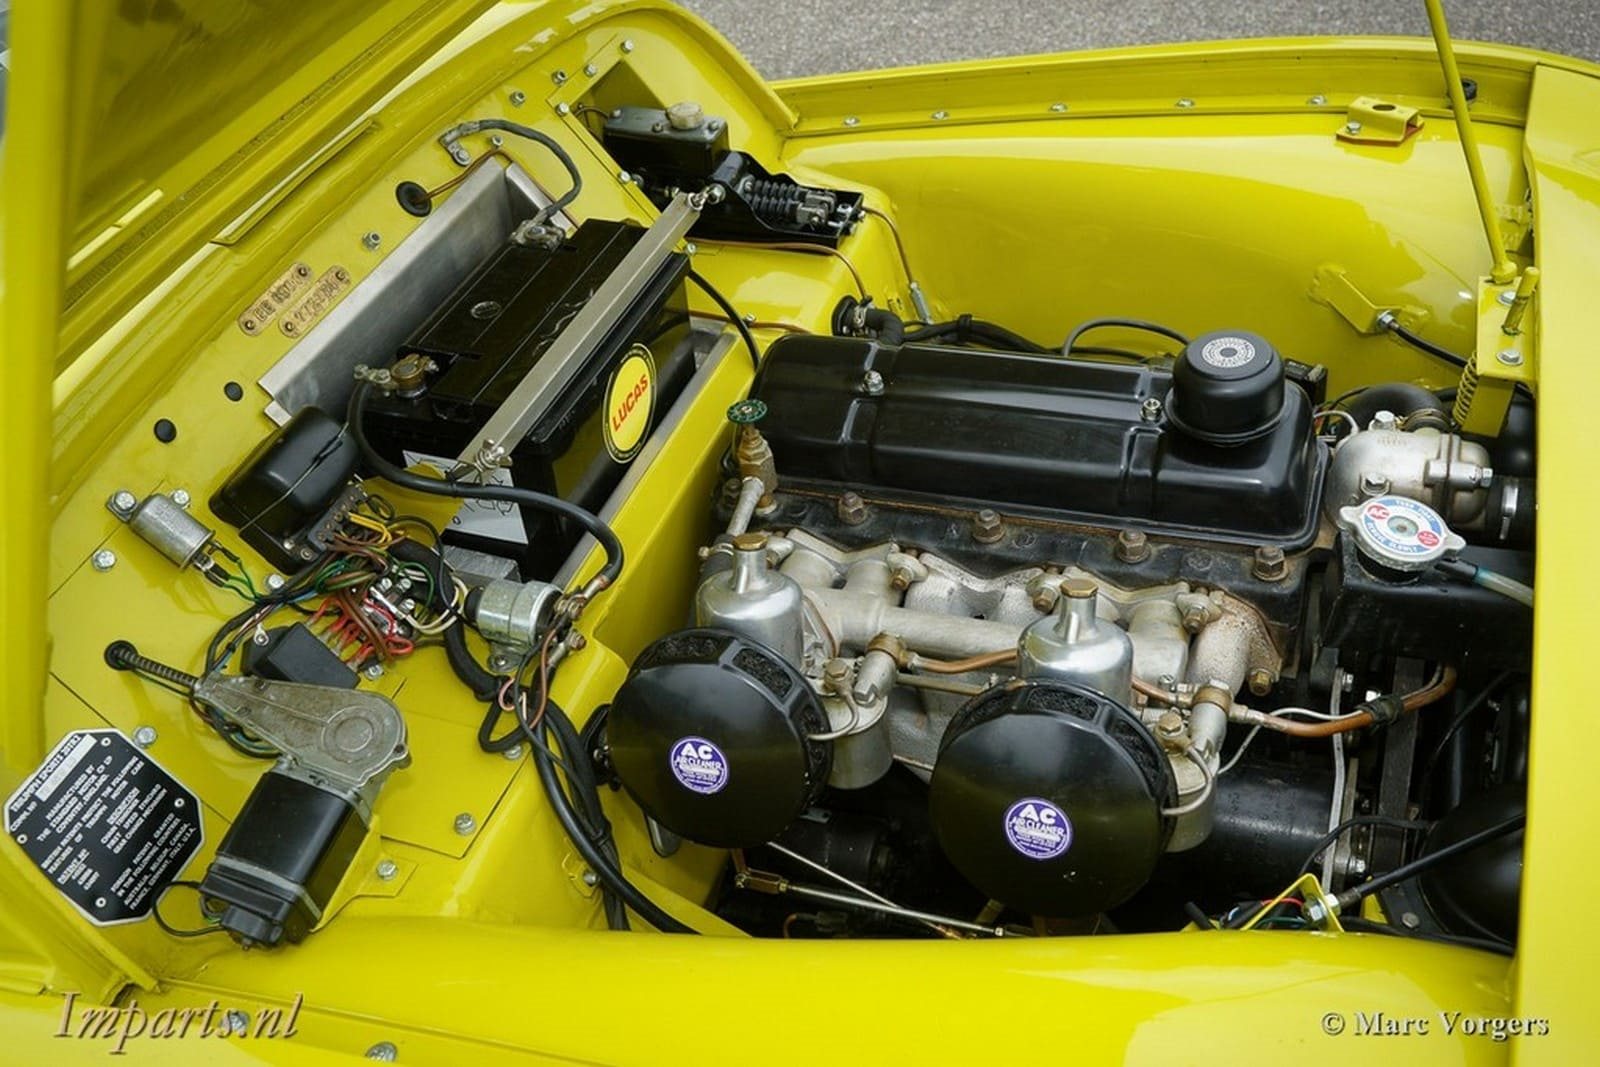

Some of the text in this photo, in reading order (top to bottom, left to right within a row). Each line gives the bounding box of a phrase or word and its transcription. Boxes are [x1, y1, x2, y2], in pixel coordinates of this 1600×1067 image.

[612, 374, 648, 432] LUCAS
[681, 743, 713, 760] AC
[9, 777, 43, 813] TRIUMPH
[38, 752, 64, 781] SPORTS
[44, 772, 88, 821] MANUFACTURED
[105, 786, 140, 825] DESCRIPTION
[36, 827, 51, 842] THE
[49, 795, 79, 828] STANDARD
[77, 772, 98, 796] MOTOR
[40, 845, 62, 869] BRITISH
[59, 820, 83, 847] PATENTS
[80, 796, 103, 822] PROTECT
[100, 785, 113, 798] THE
[109, 754, 138, 787] FOLLOWING
[47, 845, 73, 874] FEATURES
[73, 832, 84, 843] OF
[85, 803, 108, 829] TRIUMPH
[109, 778, 128, 800] MOTOR
[99, 797, 140, 844] CHAIN TENSIONER
[106, 831, 122, 849] FIRST
[122, 811, 139, 829] SPEED
[1019, 804, 1057, 825] AC
[109, 812, 175, 893] FOREIGN PATENTS GRANTED
[112, 837, 127, 854] GEAR
[124, 816, 145, 840] CHANGE
[56, 857, 80, 885] PATENT
[122, 875, 135, 888] THE
[131, 844, 159, 877] FOLLOWING
